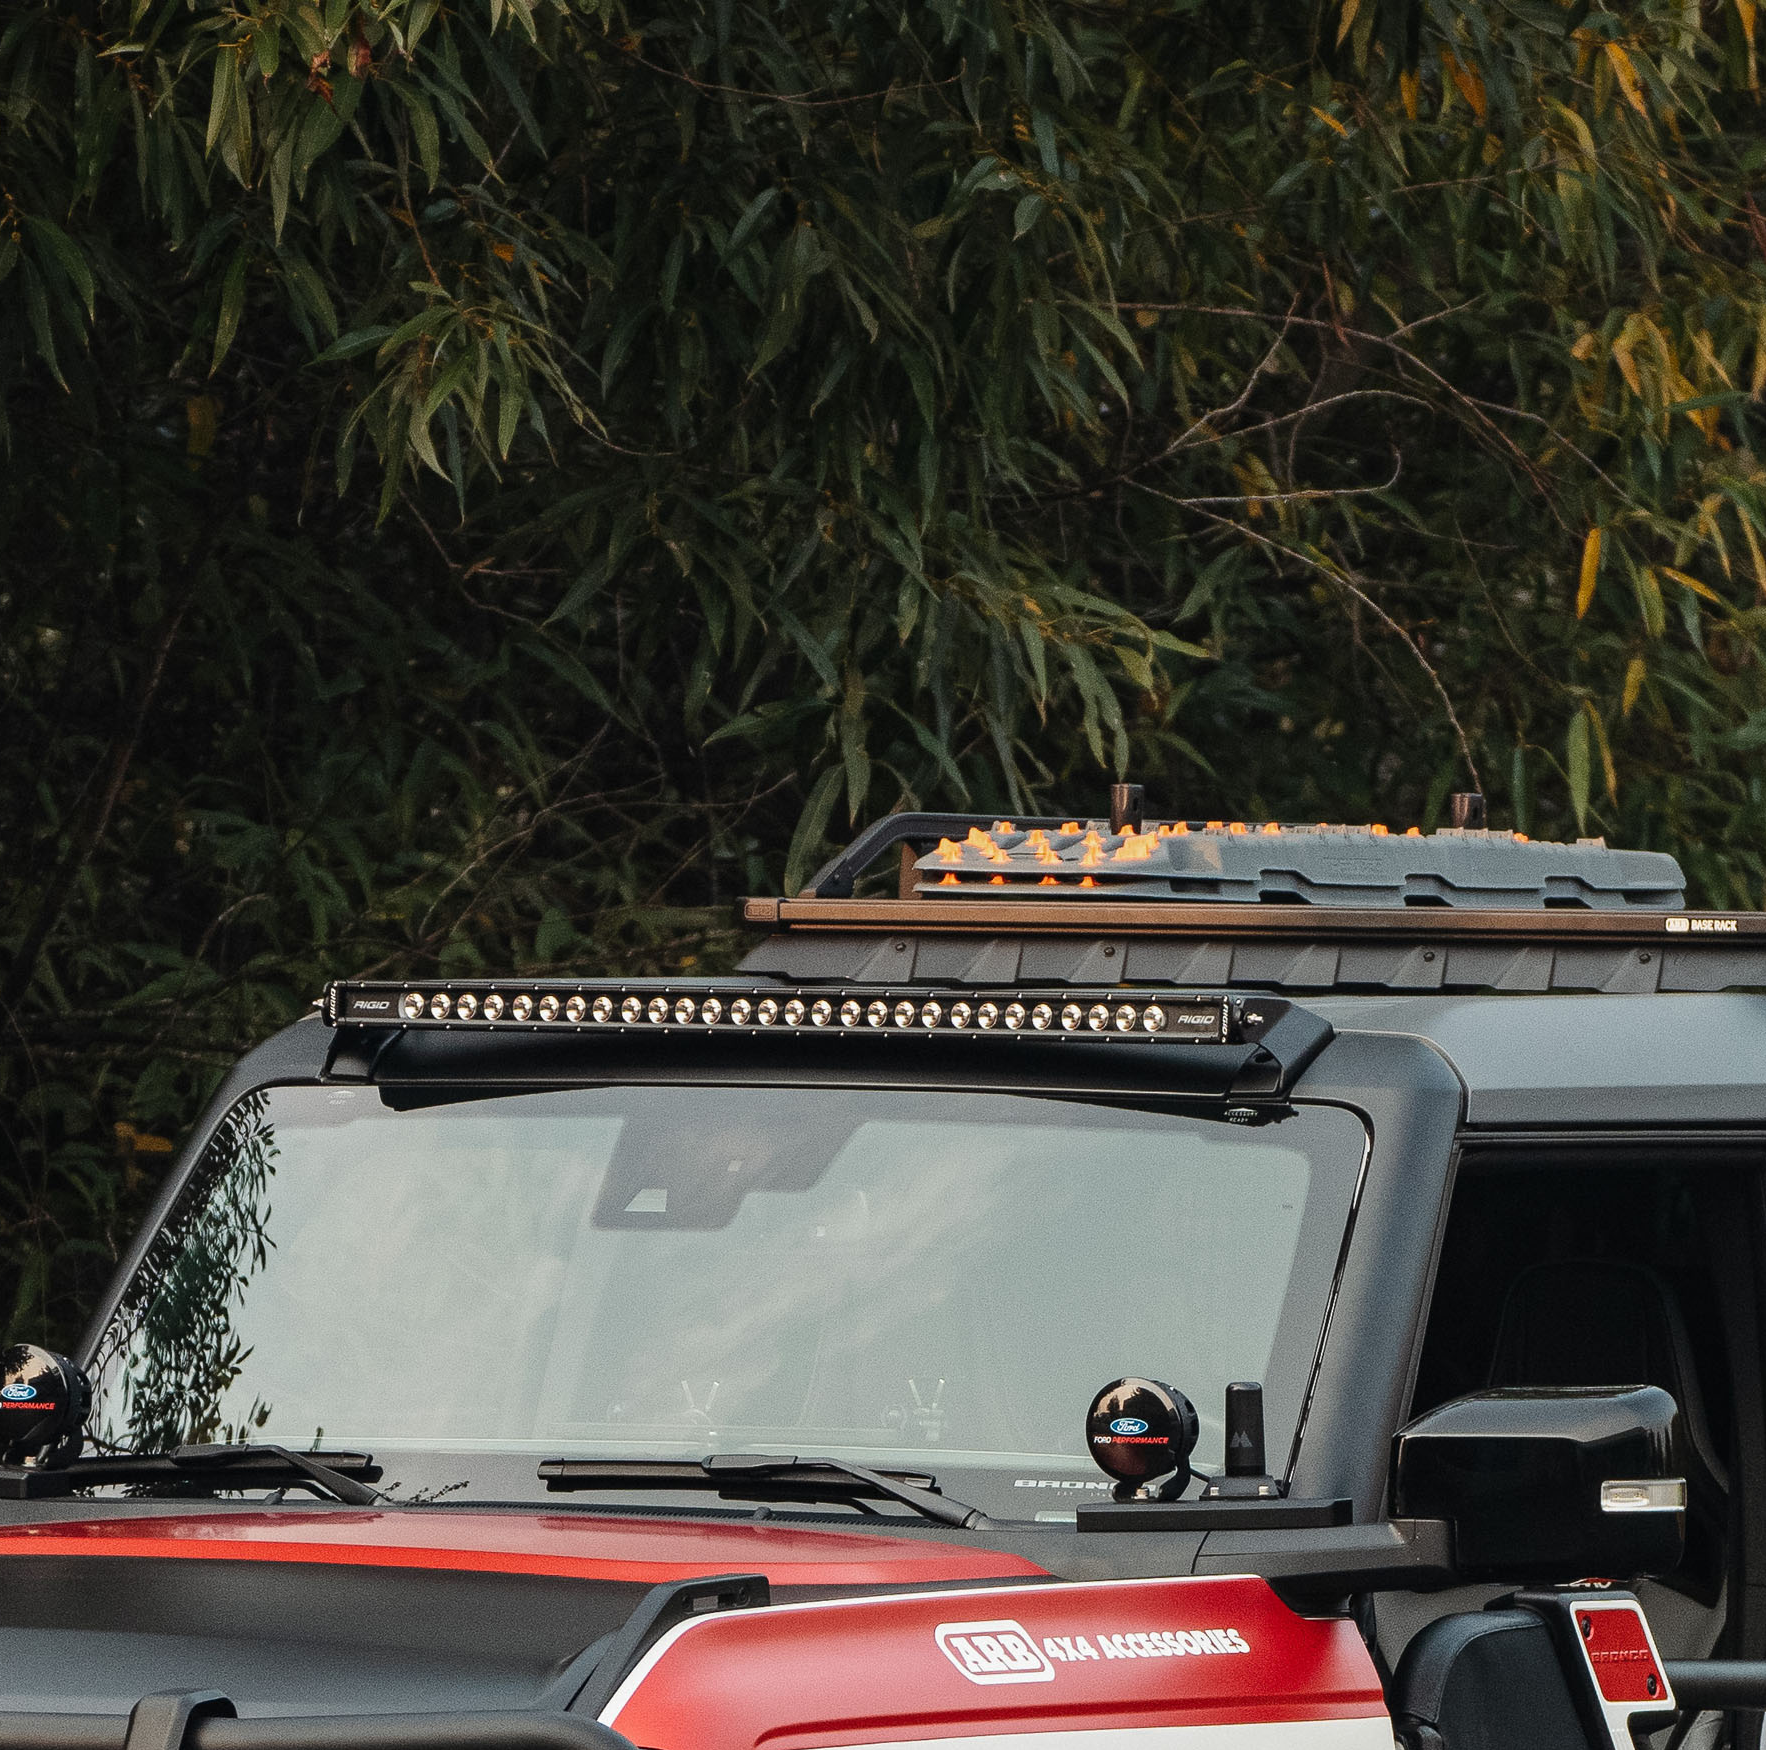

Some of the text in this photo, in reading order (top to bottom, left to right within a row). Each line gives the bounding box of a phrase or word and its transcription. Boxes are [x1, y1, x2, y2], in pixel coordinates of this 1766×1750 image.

[1691, 919, 1713, 931] BASE
[1714, 920, 1737, 932] RACK
[353, 1001, 390, 1009] RIGID
[1177, 1015, 1215, 1024] RIGID
[2, 1402, 55, 1410] PERFORMANCE
[1094, 1436, 1111, 1444] FORD
[949, 1628, 1251, 1673] ARB 4X4 ACCESSORIES
